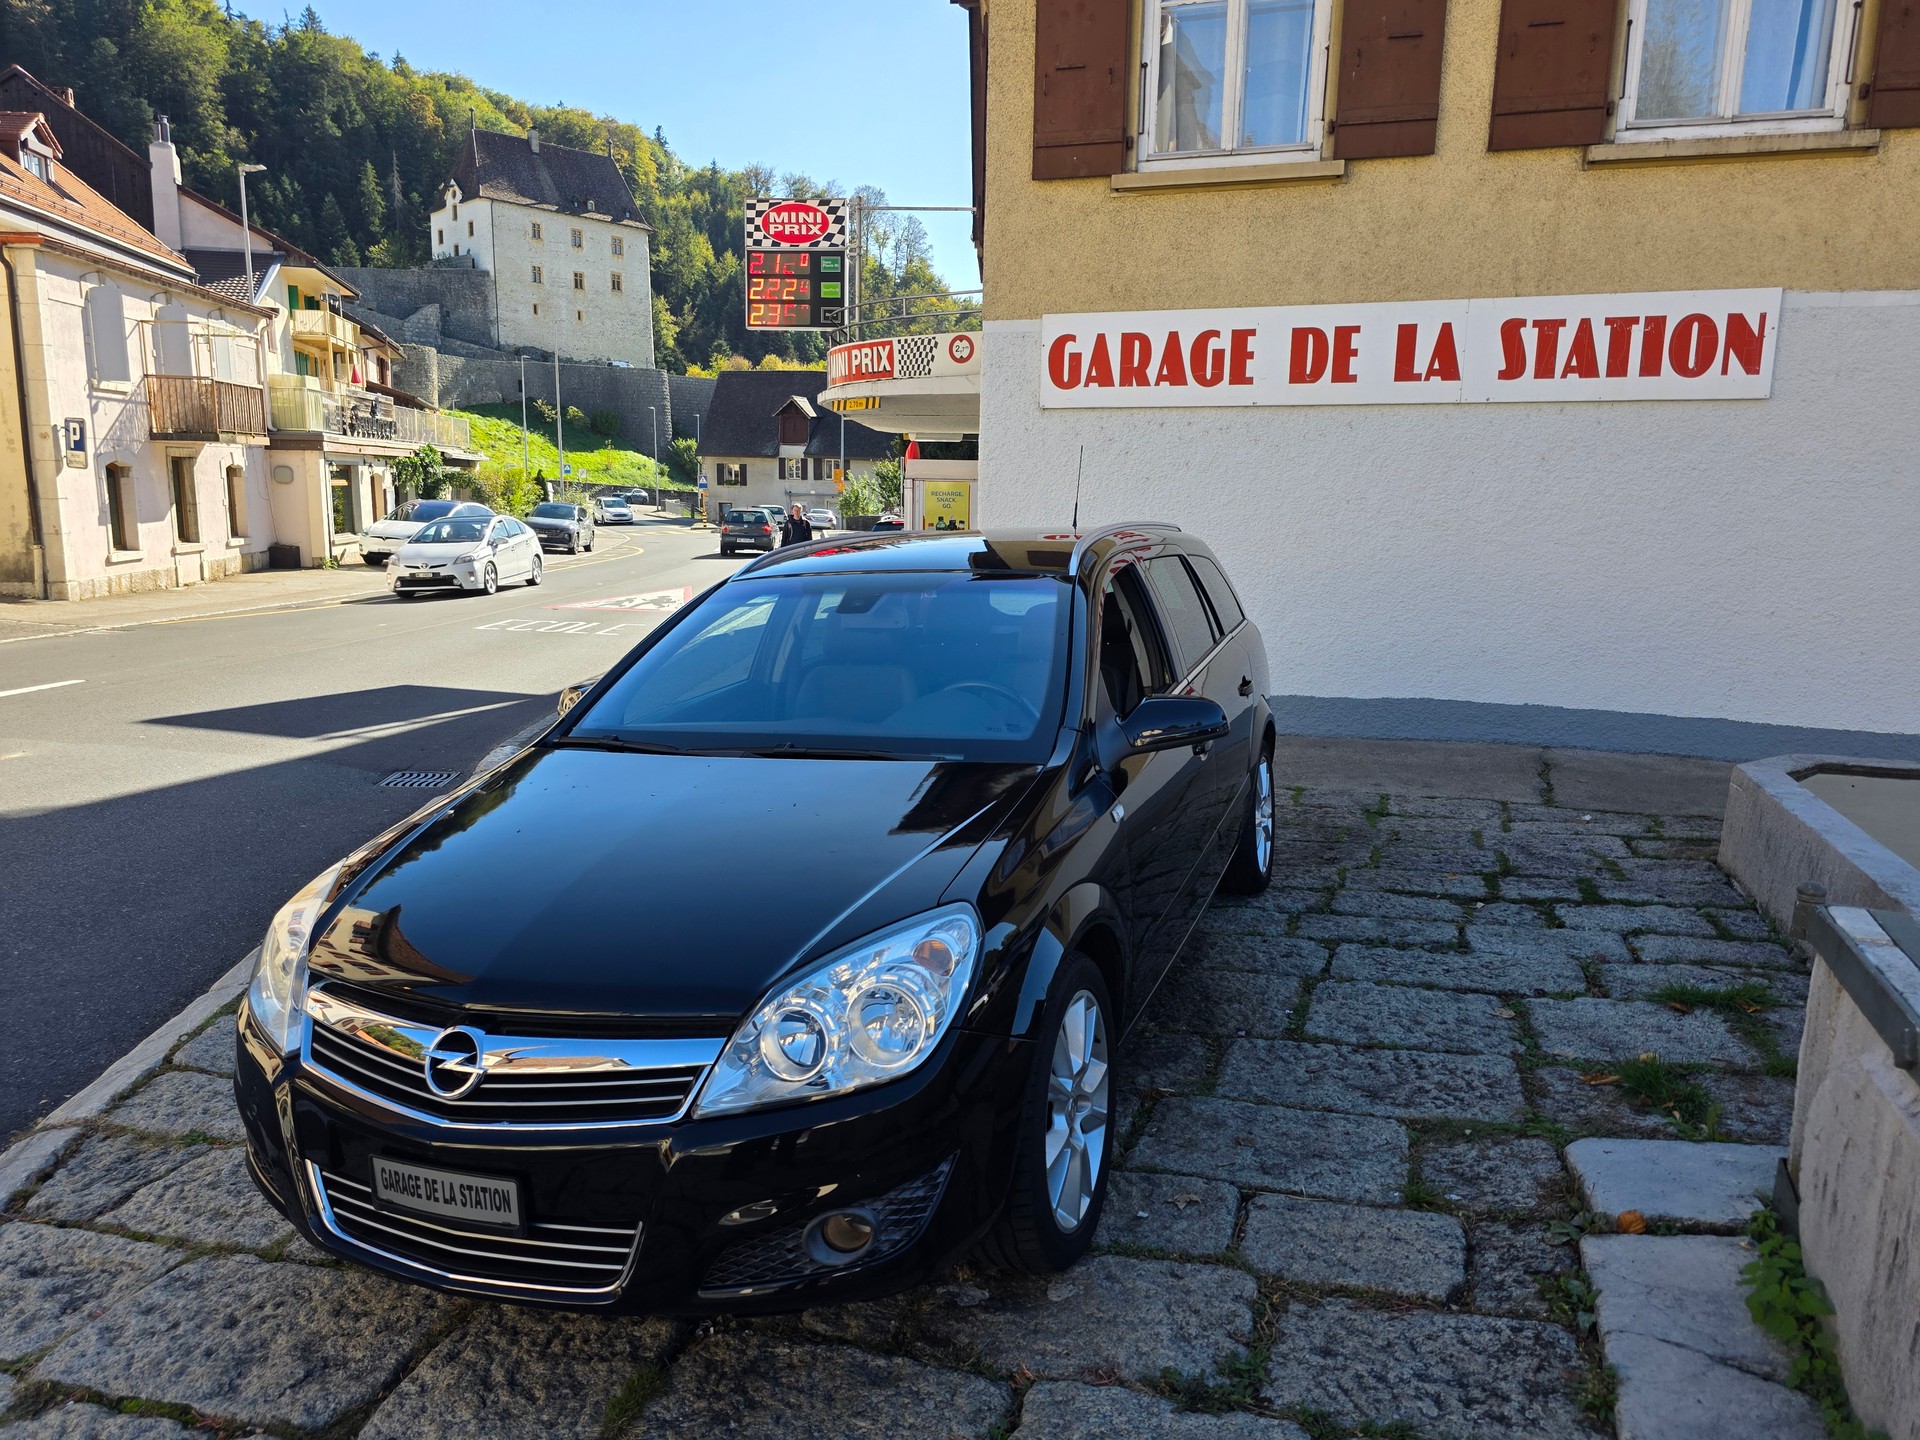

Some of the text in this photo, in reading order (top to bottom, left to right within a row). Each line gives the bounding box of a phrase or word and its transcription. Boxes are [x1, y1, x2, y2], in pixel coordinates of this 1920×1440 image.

[769, 212, 822, 223] MINI
[769, 224, 822, 235] PRIX
[851, 345, 891, 375] PRIX
[1047, 311, 1767, 390] GARAGE DE LA STATION
[69, 422, 80, 449] P
[472, 619, 646, 635] ECOLE
[380, 1166, 512, 1214] GARAGE DE LA STATION
